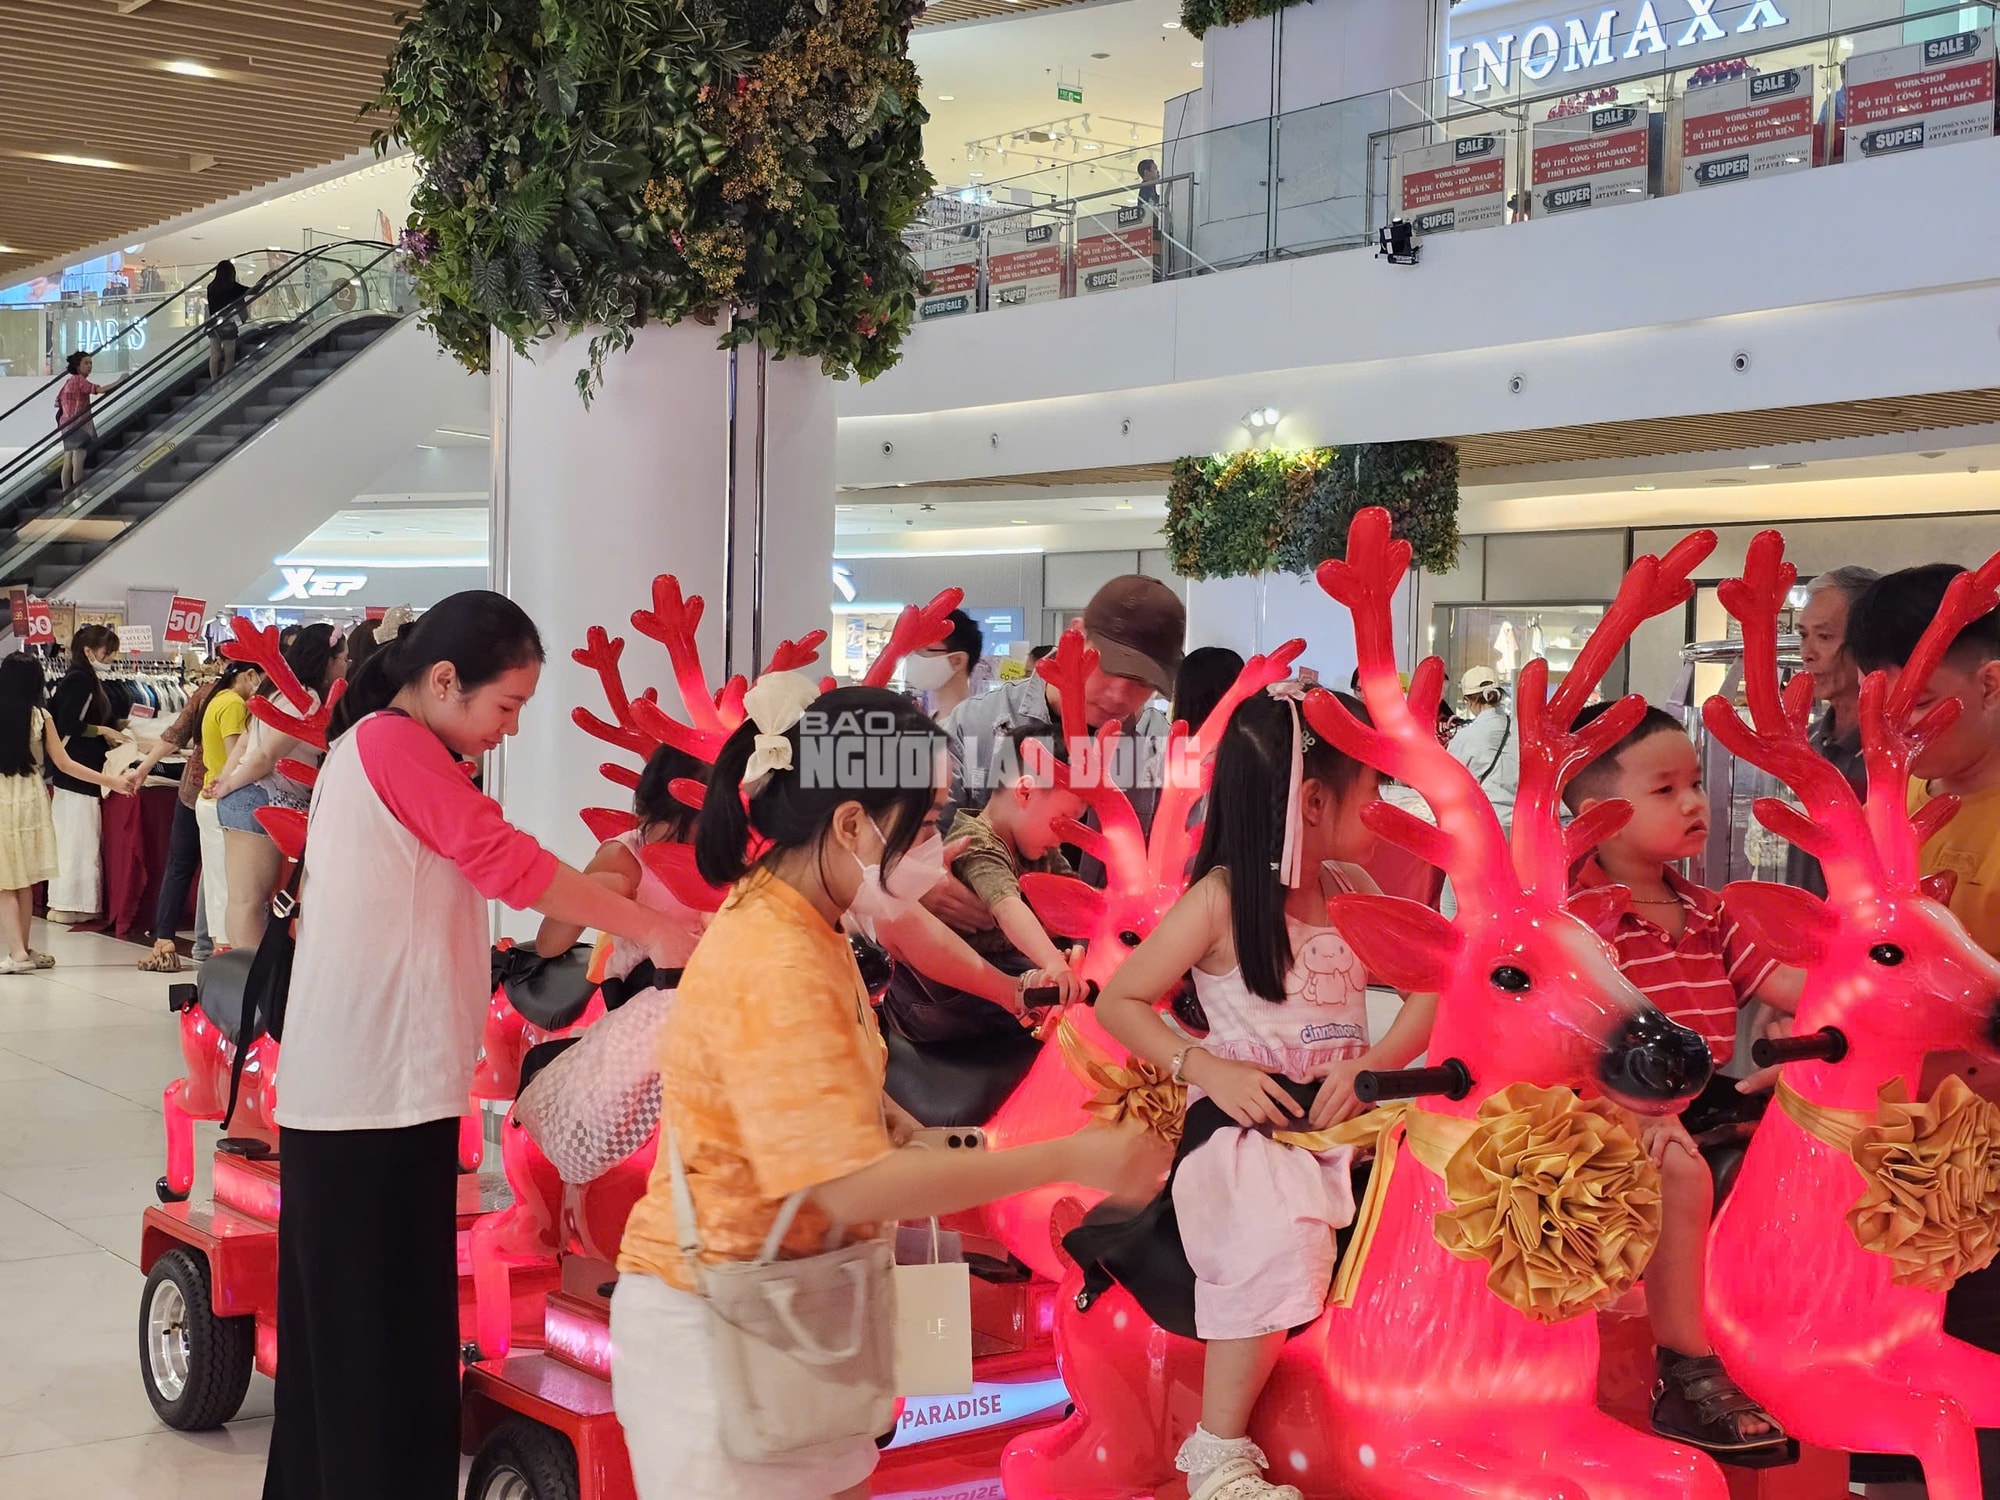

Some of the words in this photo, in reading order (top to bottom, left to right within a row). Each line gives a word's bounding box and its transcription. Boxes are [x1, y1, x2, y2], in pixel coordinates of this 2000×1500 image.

[1448, 0, 1788, 98] INOMAXX
[1928, 37, 1964, 58] SALE
[1753, 74, 1785, 93] SALE
[1895, 73, 1946, 90] WORKSHOP
[1896, 89, 1921, 101] CÔNG
[1930, 78, 1983, 95] HANDMADE
[1953, 91, 1975, 103] KIỆN
[1595, 110, 1623, 126] SALE
[1725, 108, 1770, 122] WORKSHOP
[1755, 113, 1801, 128] HANDMADE
[1960, 123, 1989, 135] STATION
[1722, 135, 1749, 146] TRANG
[1875, 127, 1922, 149] SUPER
[1458, 139, 1483, 154] SALE
[1569, 140, 1609, 152] WORKSHOP
[1596, 145, 1637, 158] HANDMADE
[1434, 167, 1470, 179] WORKSHOP
[1708, 159, 1748, 179] SUPER
[1458, 172, 1496, 185] HANDMADE
[1554, 187, 1590, 206] SUPER
[1119, 208, 1138, 223] SALE
[1422, 212, 1454, 229] SUPER
[1027, 228, 1046, 241] SALE
[1092, 273, 1117, 287] SUPER
[1003, 289, 1026, 302] SUPER
[925, 302, 945, 315] SUPER
[946, 299, 962, 311] SALE
[168, 609, 202, 634] 50
[902, 1394, 1002, 1430] PARADISE
